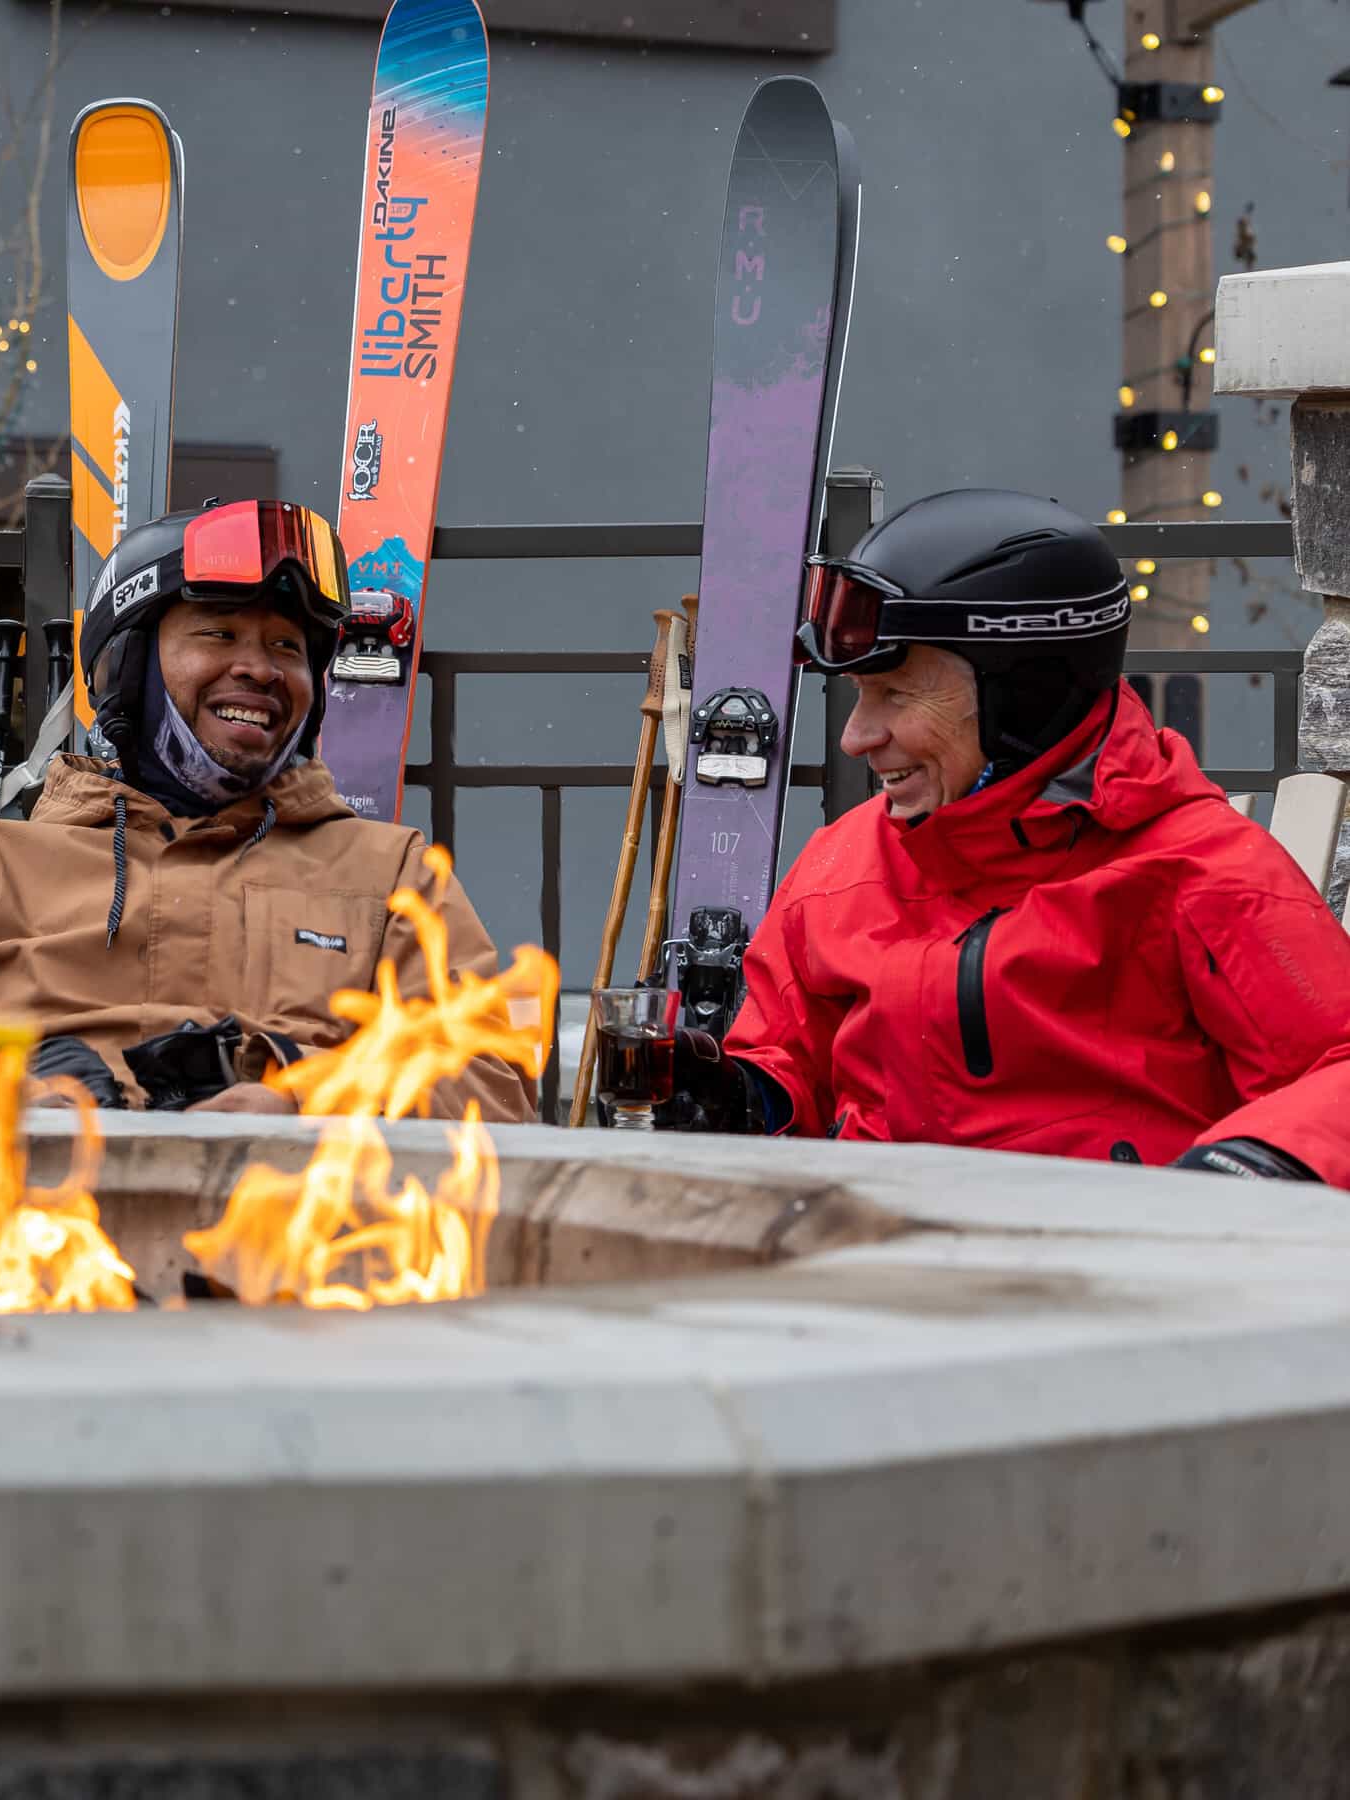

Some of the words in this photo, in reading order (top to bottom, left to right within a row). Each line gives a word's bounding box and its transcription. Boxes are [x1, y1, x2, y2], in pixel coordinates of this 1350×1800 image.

[373, 105, 397, 228] DAKINE
[404, 253, 447, 380] SMITH
[357, 561, 401, 575] VMT
[115, 579, 139, 608] SPY
[710, 831, 741, 855] 107
